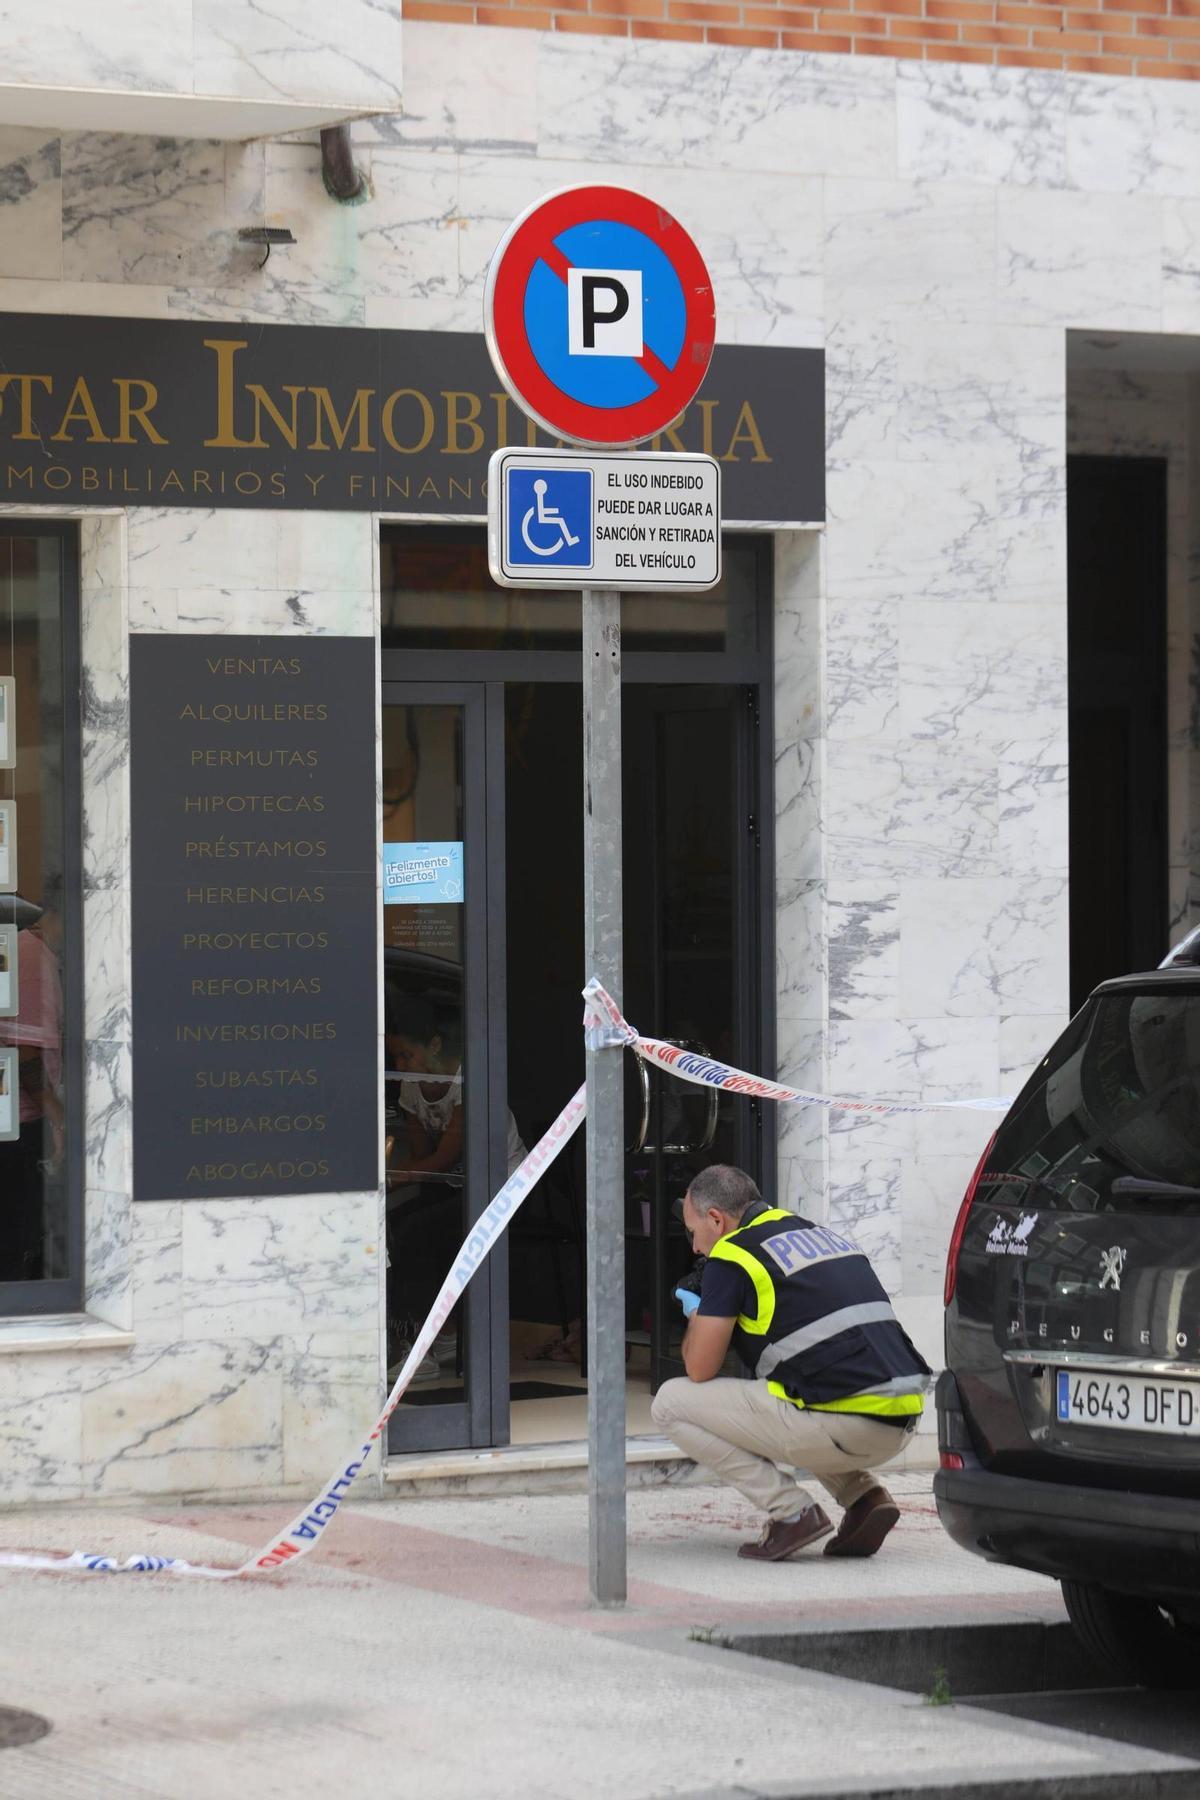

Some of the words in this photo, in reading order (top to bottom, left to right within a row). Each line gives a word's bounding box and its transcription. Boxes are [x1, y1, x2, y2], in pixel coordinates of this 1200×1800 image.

[581, 275, 630, 349] P
[0, 374, 169, 445] TAR
[307, 473, 325, 497] Y
[607, 473, 622, 487] EL
[624, 474, 648, 488] USO
[650, 475, 704, 490] INDEBIDO
[597, 499, 635, 514] PUEDE
[638, 501, 662, 515] DAR
[664, 502, 703, 516] LUGAR
[705, 503, 713, 517] A
[595, 523, 646, 541] SANCIÓN
[648, 527, 657, 541] Y
[659, 528, 715, 543] RETIRADA
[615, 553, 637, 568] DEL
[639, 551, 696, 569] VEHÍCULO
[207, 658, 301, 675] VENTAS
[179, 703, 328, 723] ALQUILERES
[191, 750, 318, 767] PERMUTAS
[184, 795, 325, 812] HIPOTECAS
[185, 835, 327, 858] PRÉSTAMOS
[388, 869, 436, 885] abiertos!
[187, 886, 325, 904] HERENCIAS
[183, 932, 329, 950] PROYECTOS
[191, 977, 321, 996] REFORMAS
[175, 1023, 337, 1042] INVERSIONES
[195, 1069, 319, 1088] SUBASTAS
[190, 1115, 327, 1135] EMBARGOS
[185, 1160, 330, 1182] ABOGADOS
[1072, 1379, 1131, 1420] 4643
[1143, 1386, 1193, 1426] DFD
